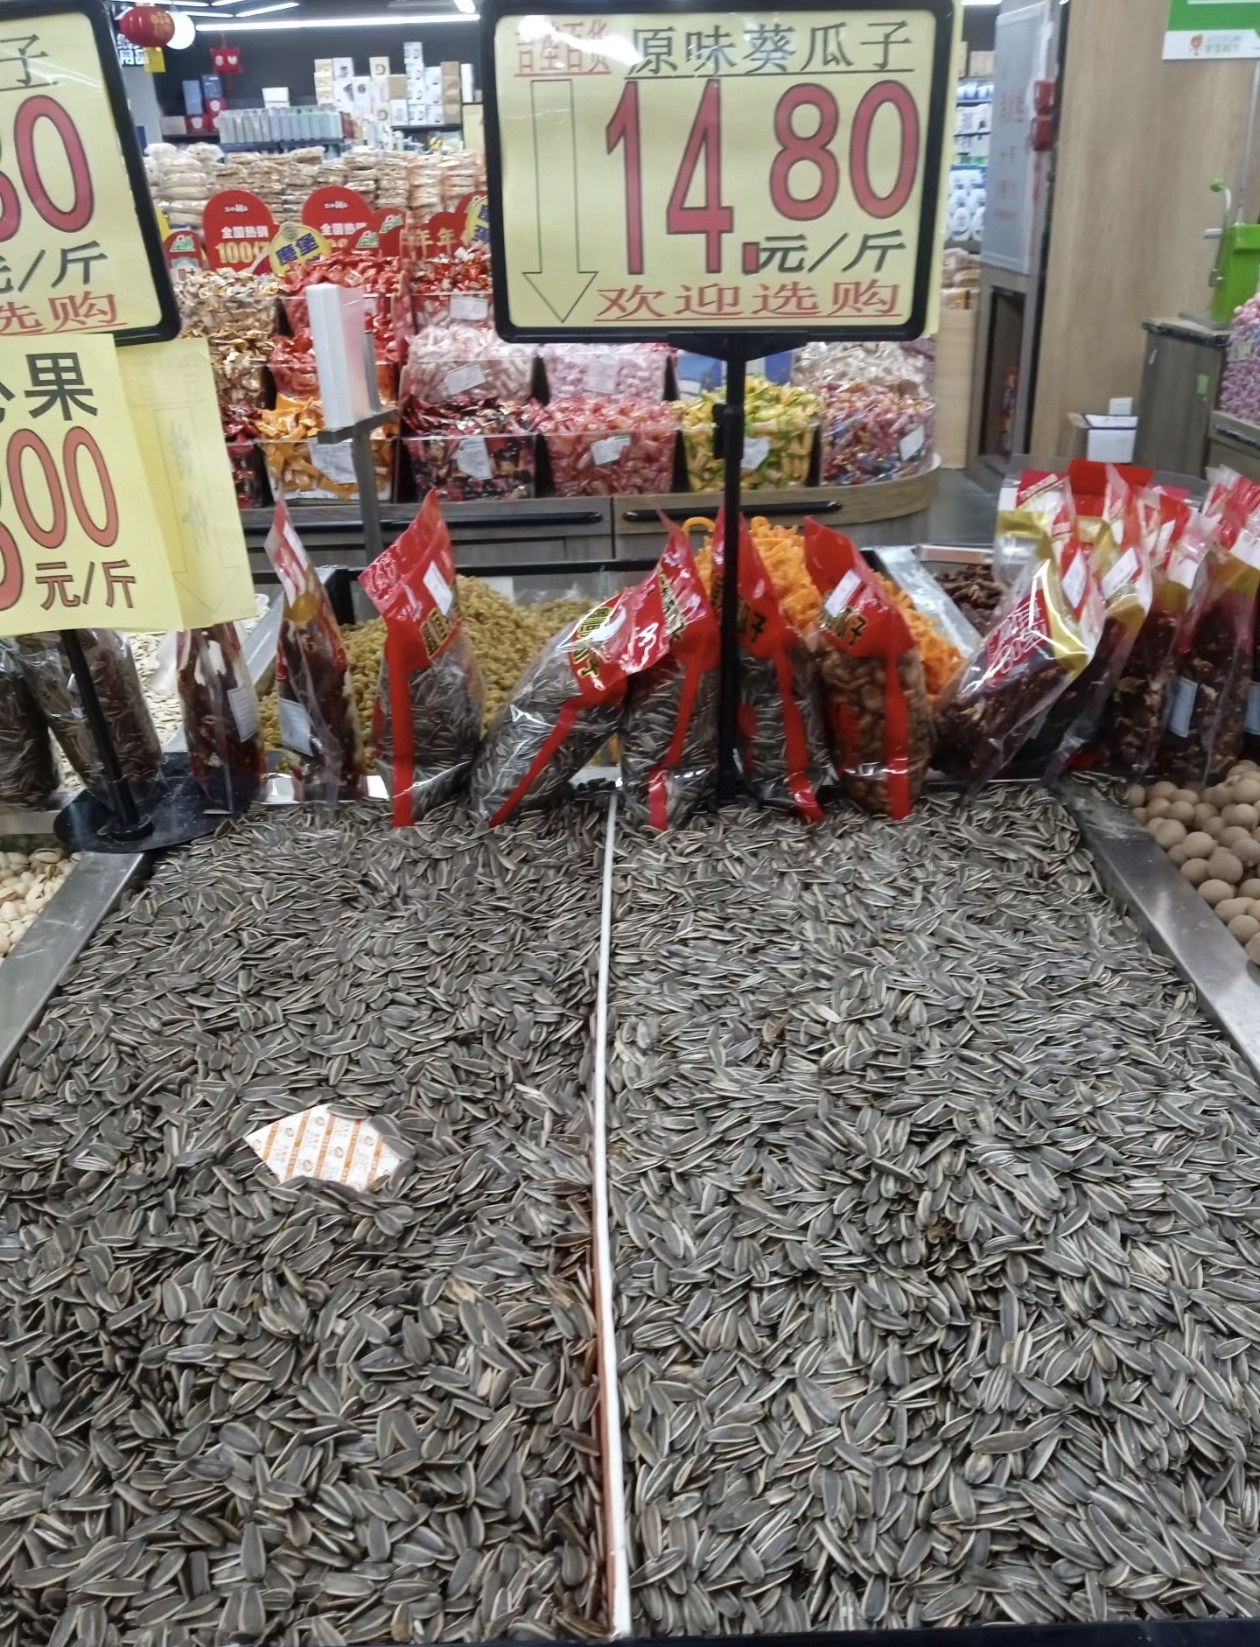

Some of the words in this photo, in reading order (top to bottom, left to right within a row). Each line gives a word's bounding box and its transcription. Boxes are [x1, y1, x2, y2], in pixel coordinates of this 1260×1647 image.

[0, 34, 49, 86] 子
[626, 20, 915, 77] 原味葵瓜子
[605, 78, 920, 275] 14.80
[759, 230, 907, 273] 元/斤
[596, 279, 903, 319] 欢迎选购
[35, 559, 137, 611] 元/斤
